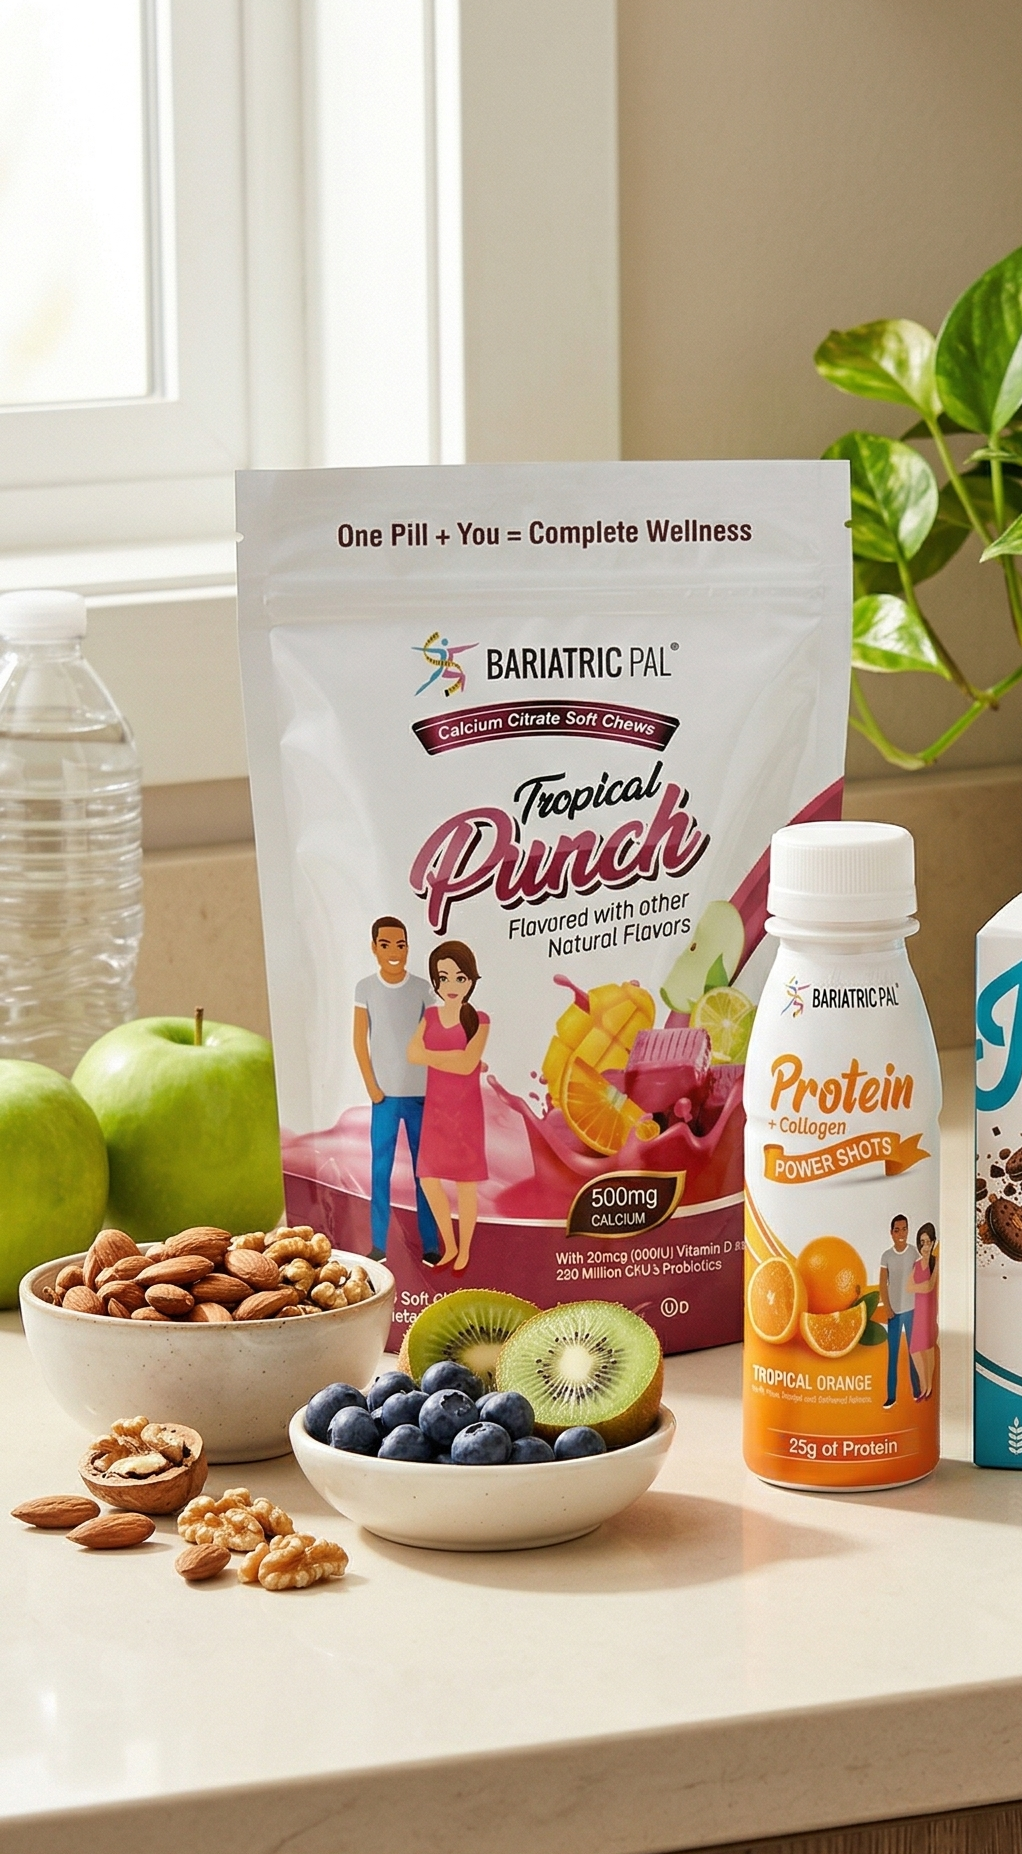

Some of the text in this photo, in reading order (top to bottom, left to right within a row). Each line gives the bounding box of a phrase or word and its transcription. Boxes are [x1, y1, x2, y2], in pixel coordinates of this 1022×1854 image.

[338, 519, 752, 549] One Pill + You = Complete Wellness
[487, 647, 622, 680] BARIATRIC
[438, 711, 655, 740] Calcium Citrate Soft Chews
[513, 760, 663, 825] Tropical
[409, 783, 711, 936] Punch
[509, 893, 689, 939] Flavored with other
[549, 918, 691, 958] Natural Flavors
[812, 987, 877, 1008] BARIATRIC
[770, 1053, 914, 1114] Protein
[775, 1137, 892, 1179] POWER SHOTS
[591, 1186, 658, 1208] 500mg
[591, 1212, 645, 1227] CALCIUM
[556, 1251, 584, 1265] With
[587, 1251, 628, 1264] 20mcg
[676, 1242, 720, 1257] Vitamin
[582, 1266, 622, 1279] Million
[401, 1291, 429, 1306] Soft
[752, 1364, 872, 1391] TROPICAL ORANGE
[789, 1437, 817, 1459] 25g
[843, 1438, 898, 1457] Protein
